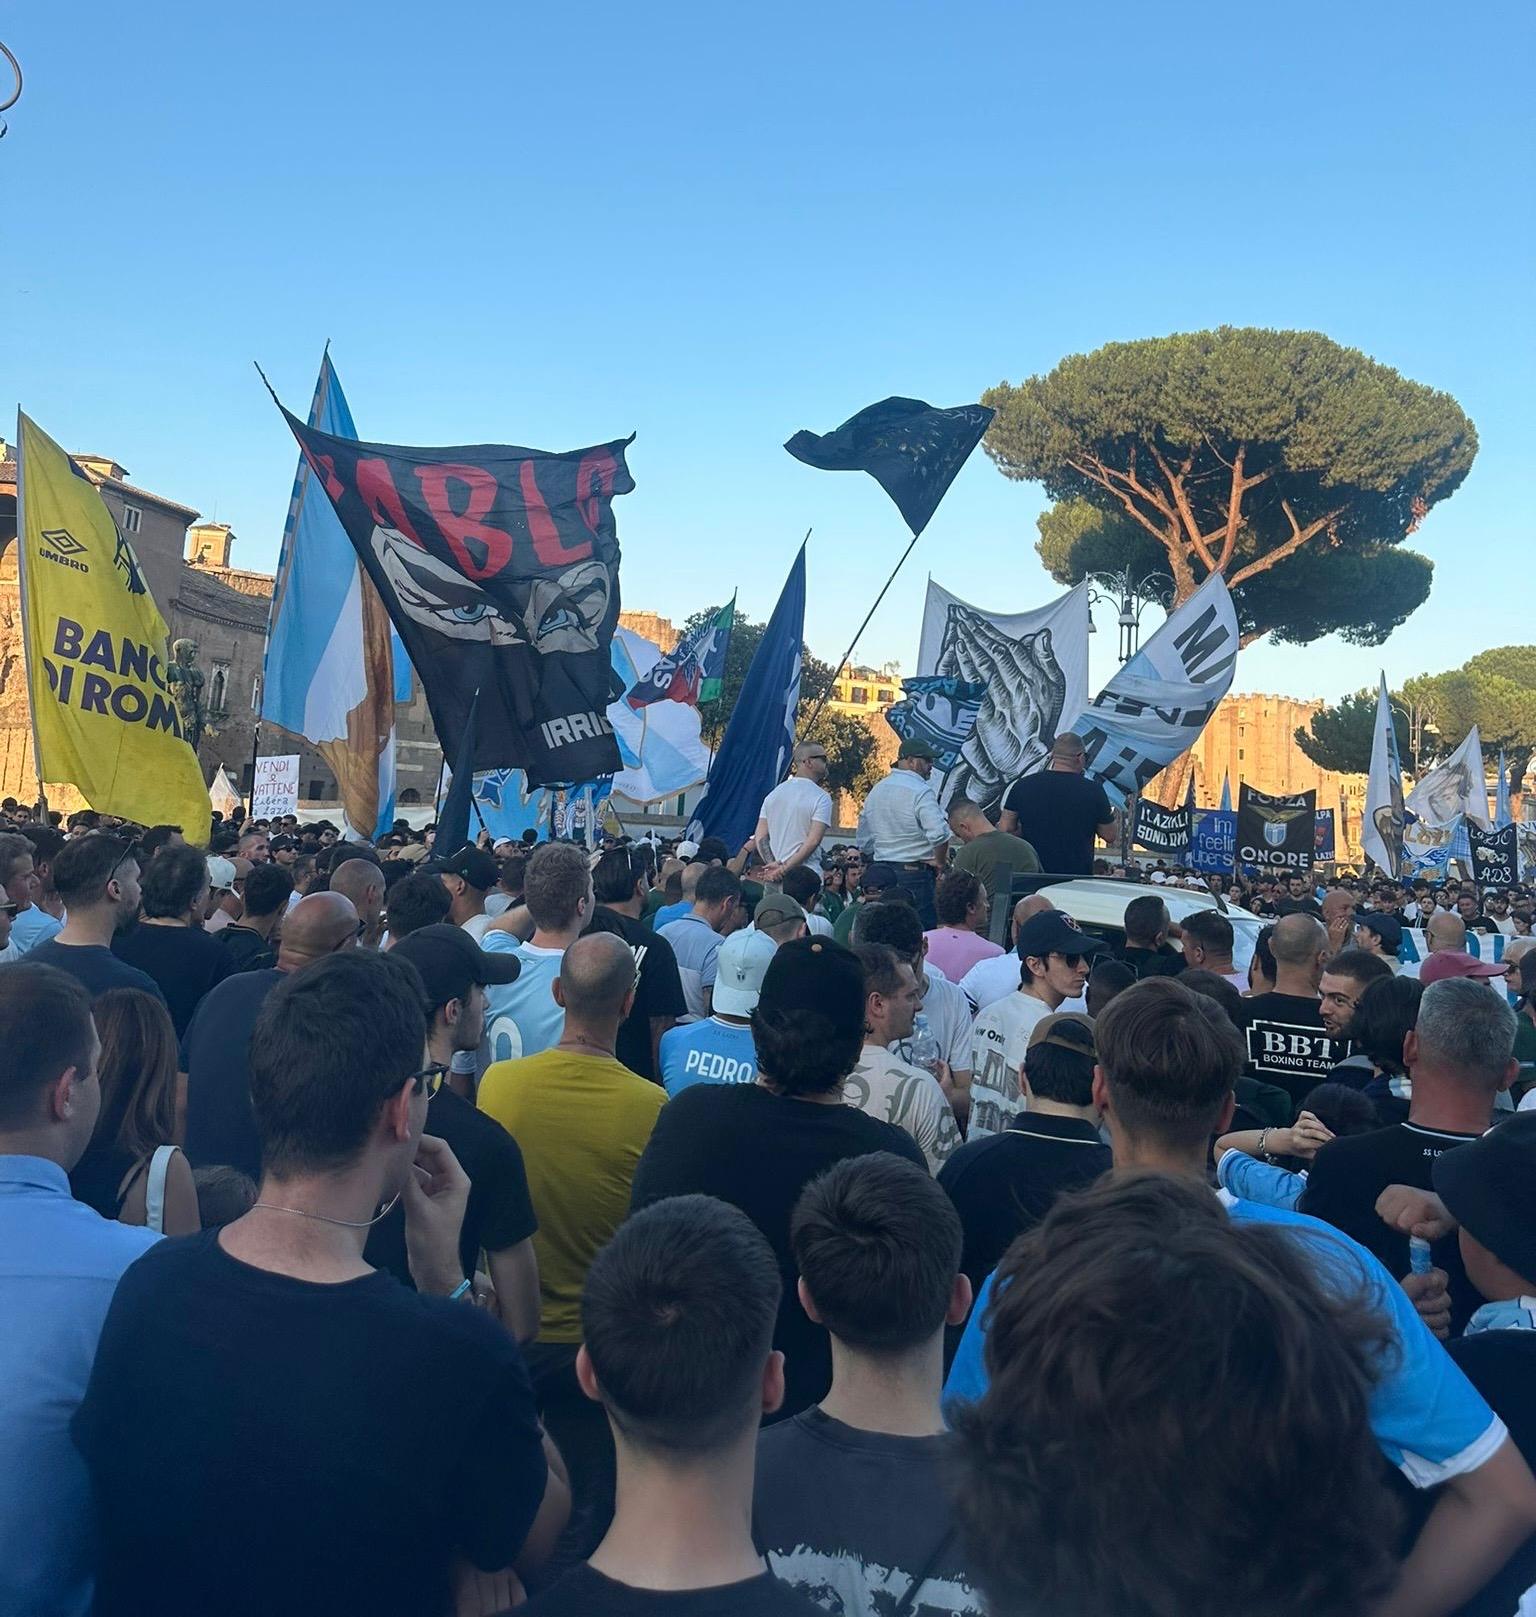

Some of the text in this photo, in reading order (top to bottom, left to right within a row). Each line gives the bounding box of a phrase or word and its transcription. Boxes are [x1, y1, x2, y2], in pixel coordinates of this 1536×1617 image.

[39, 547, 90, 574] UMBRO
[256, 759, 290, 774] VENDI
[1247, 789, 1307, 807] FORZA
[1240, 846, 1309, 868] ONORE
[1262, 1030, 1339, 1059] BBT
[685, 1049, 753, 1084] PEDRO
[1263, 1053, 1304, 1067] BOXING
